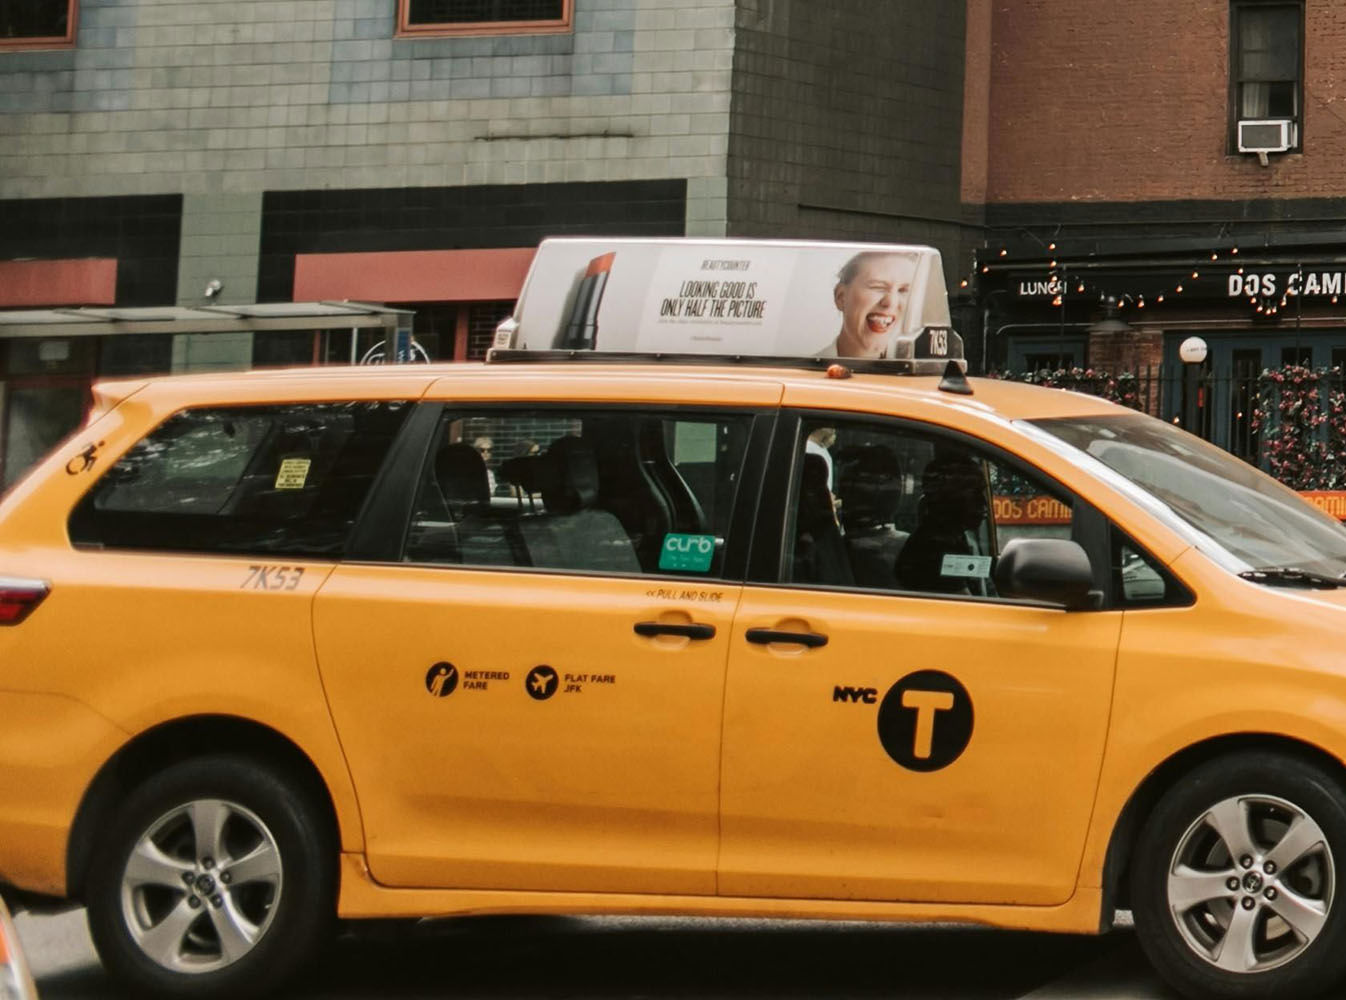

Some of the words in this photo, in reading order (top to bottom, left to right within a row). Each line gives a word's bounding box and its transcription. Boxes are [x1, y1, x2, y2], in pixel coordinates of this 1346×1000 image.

[680, 280, 720, 298] LOOKING
[720, 281, 746, 299] GOOD
[746, 282, 758, 299] IS
[1228, 273, 1276, 297] DOS
[660, 298, 683, 317] ONLY
[684, 299, 706, 317] HALF
[709, 299, 729, 318] THE
[727, 300, 767, 318] PICTURE
[994, 500, 1022, 519] DOS
[666, 536, 712, 554] curb
[240, 565, 306, 591] 7K53
[464, 671, 510, 681] METERED
[565, 674, 587, 683] FLAT
[591, 674, 616, 684] FARE
[463, 681, 488, 690] FARE
[564, 684, 582, 693] JFK
[833, 686, 878, 704] NYC
[902, 689, 954, 759] T
